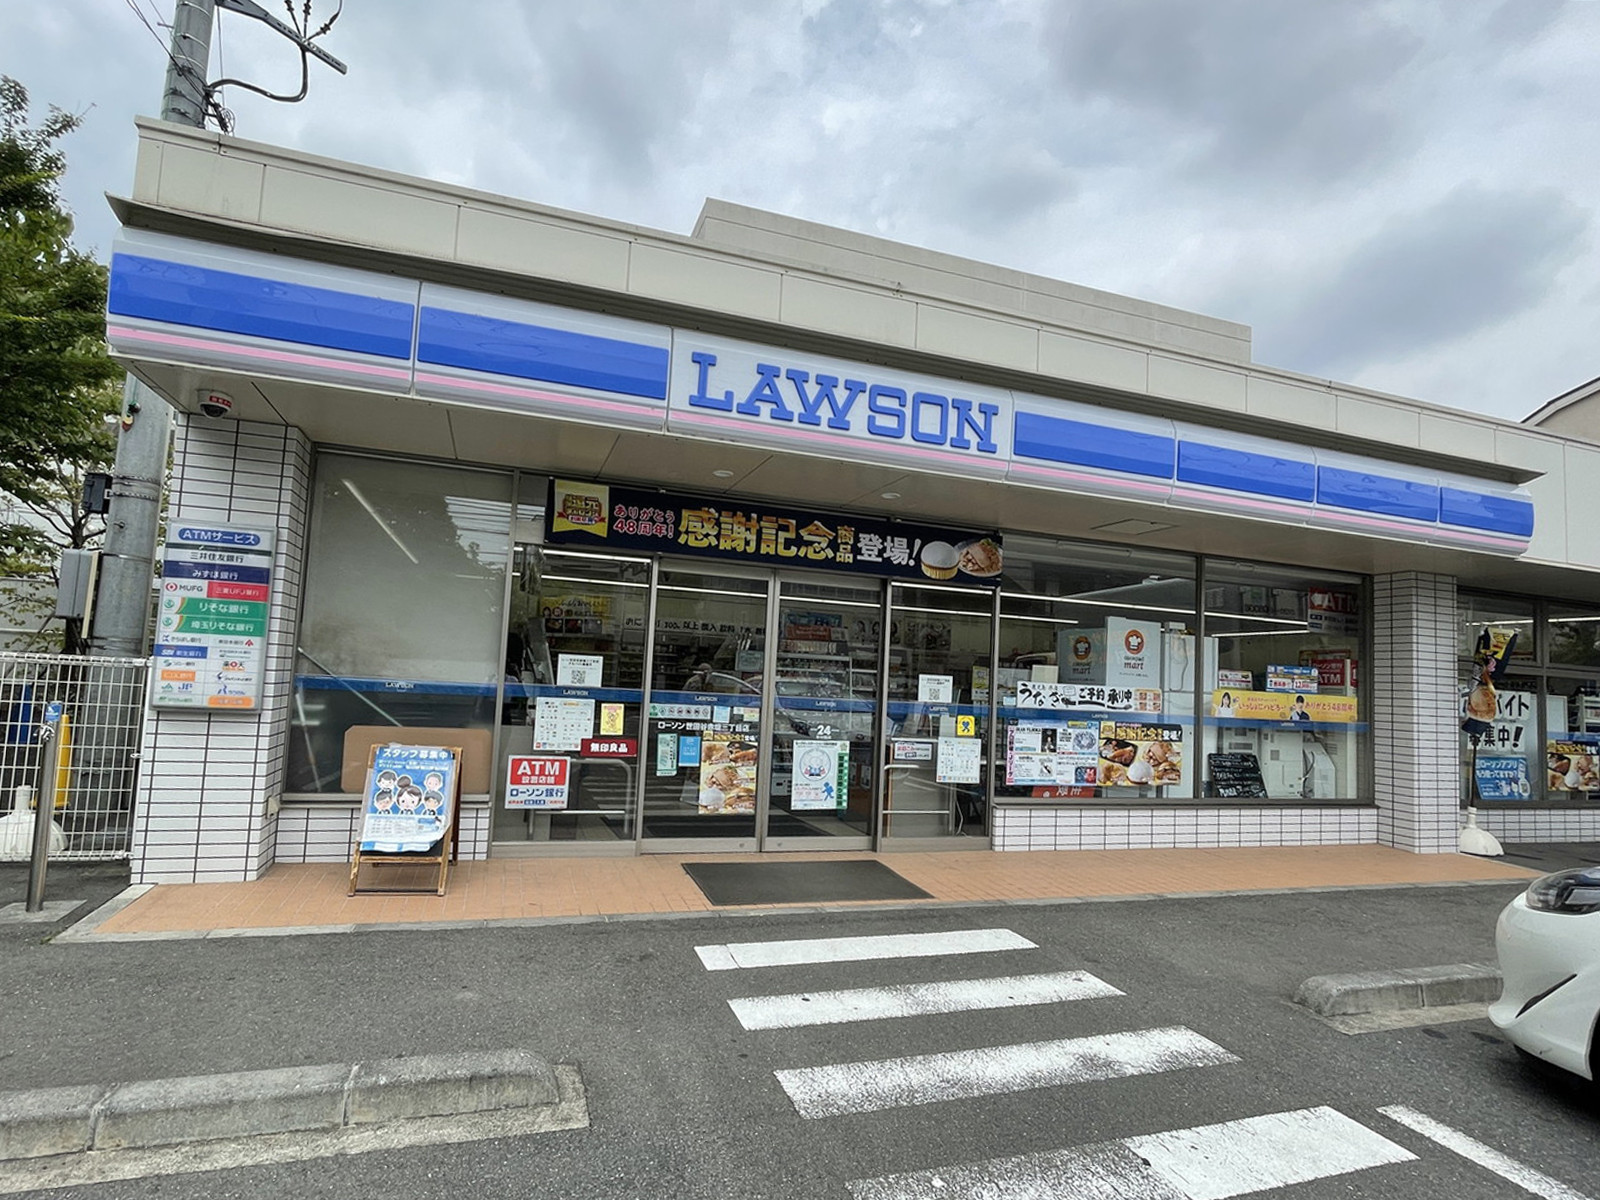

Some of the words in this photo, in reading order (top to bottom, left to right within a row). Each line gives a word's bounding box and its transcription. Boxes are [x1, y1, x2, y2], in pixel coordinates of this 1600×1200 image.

[688, 351, 999, 454] LAWSON
[613, 504, 676, 524] ありがとう
[613, 519, 676, 539] 48周年!
[182, 529, 256, 545] ATMサービス
[190, 551, 244, 564] 三井住友銀行
[192, 569, 239, 581] みずほ銀行
[179, 584, 203, 593] MUFG
[199, 602, 249, 614] りそな銀行
[191, 620, 254, 632] 埼玉りそな銀行
[657, 721, 686, 730] ローソン
[817, 724, 831, 736] 24
[591, 743, 628, 753] 無印良品
[382, 749, 449, 760] スタッフ募集中
[517, 760, 560, 776] ATM
[510, 788, 565, 798] ローソン銀行
